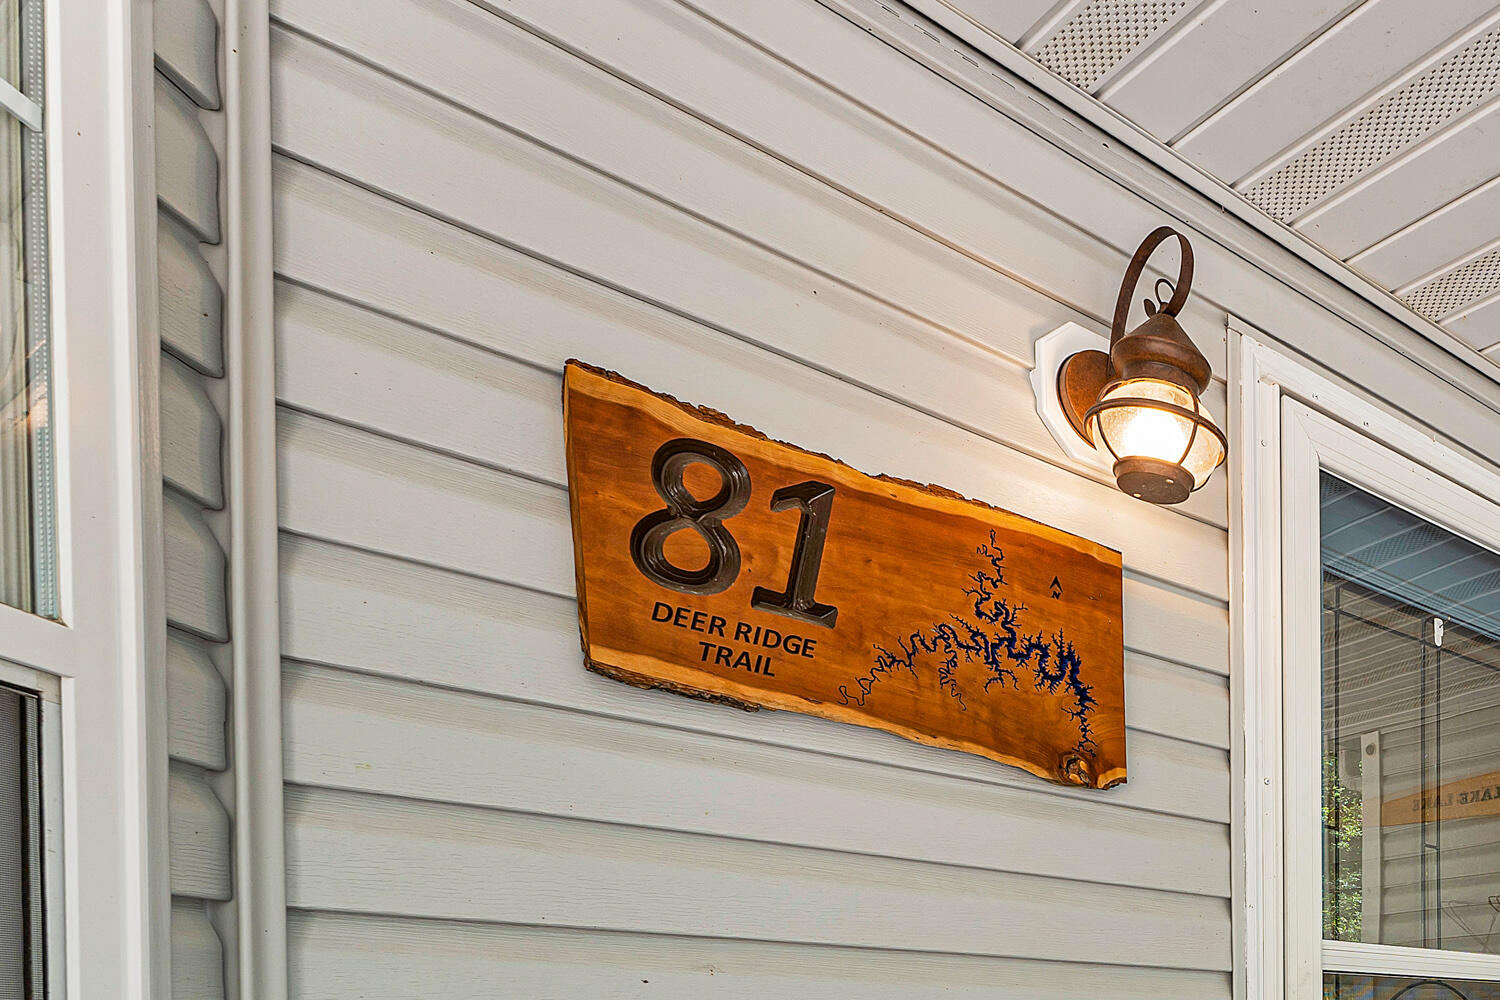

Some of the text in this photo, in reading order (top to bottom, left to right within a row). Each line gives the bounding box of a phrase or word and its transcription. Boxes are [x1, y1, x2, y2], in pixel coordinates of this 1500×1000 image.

[629, 437, 838, 630] 81
[1051, 590, 1061, 600] N
[651, 601, 818, 659] DEER RIDGE
[698, 641, 776, 677] TRAIL
